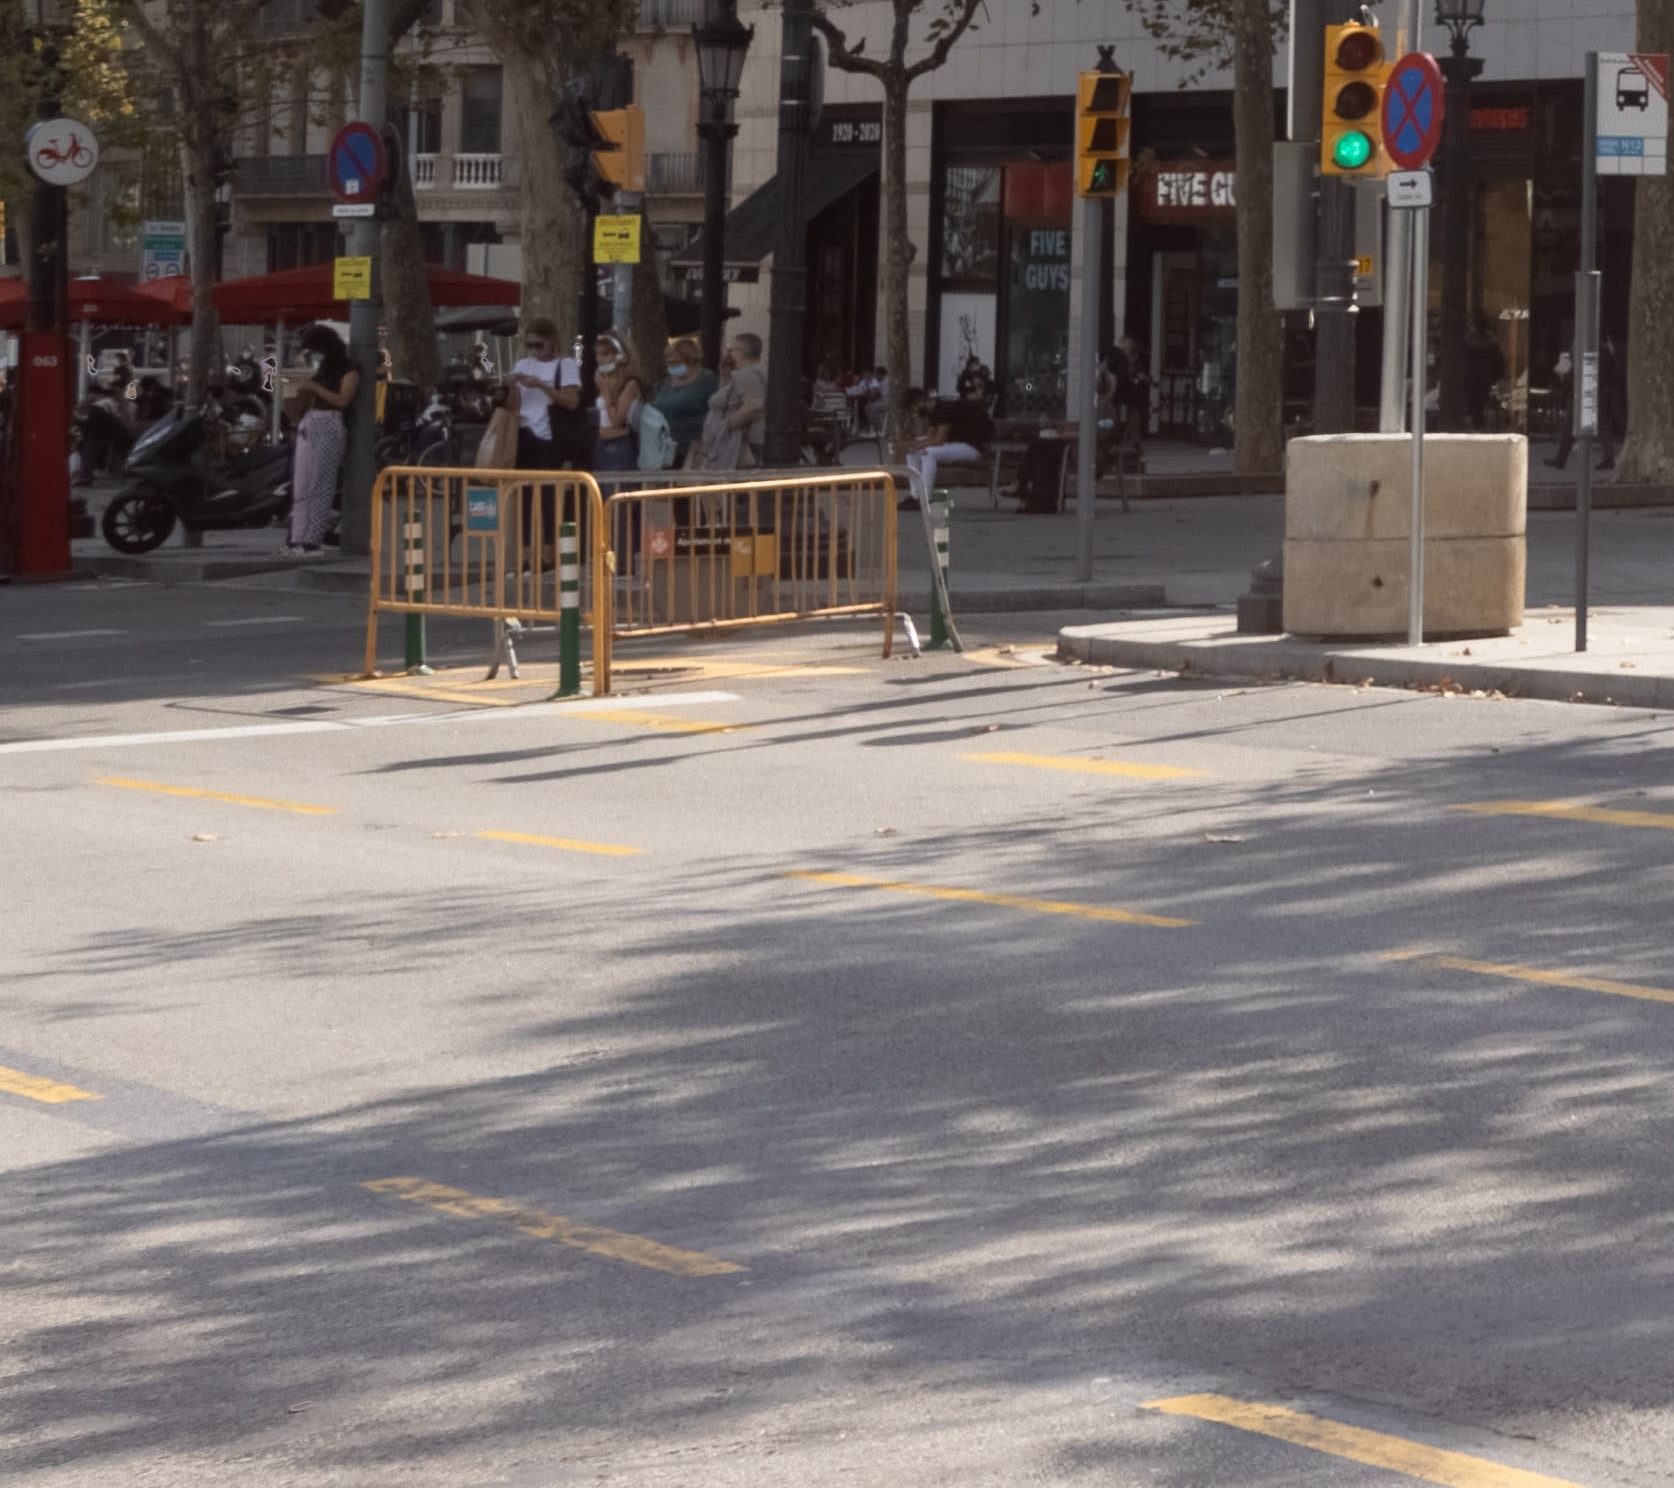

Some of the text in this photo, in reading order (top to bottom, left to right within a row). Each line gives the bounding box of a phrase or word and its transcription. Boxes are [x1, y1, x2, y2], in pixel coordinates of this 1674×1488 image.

[1157, 172, 1208, 207] FIVE
[1030, 230, 1067, 257] FIVE
[1025, 264, 1070, 291] GUYS
